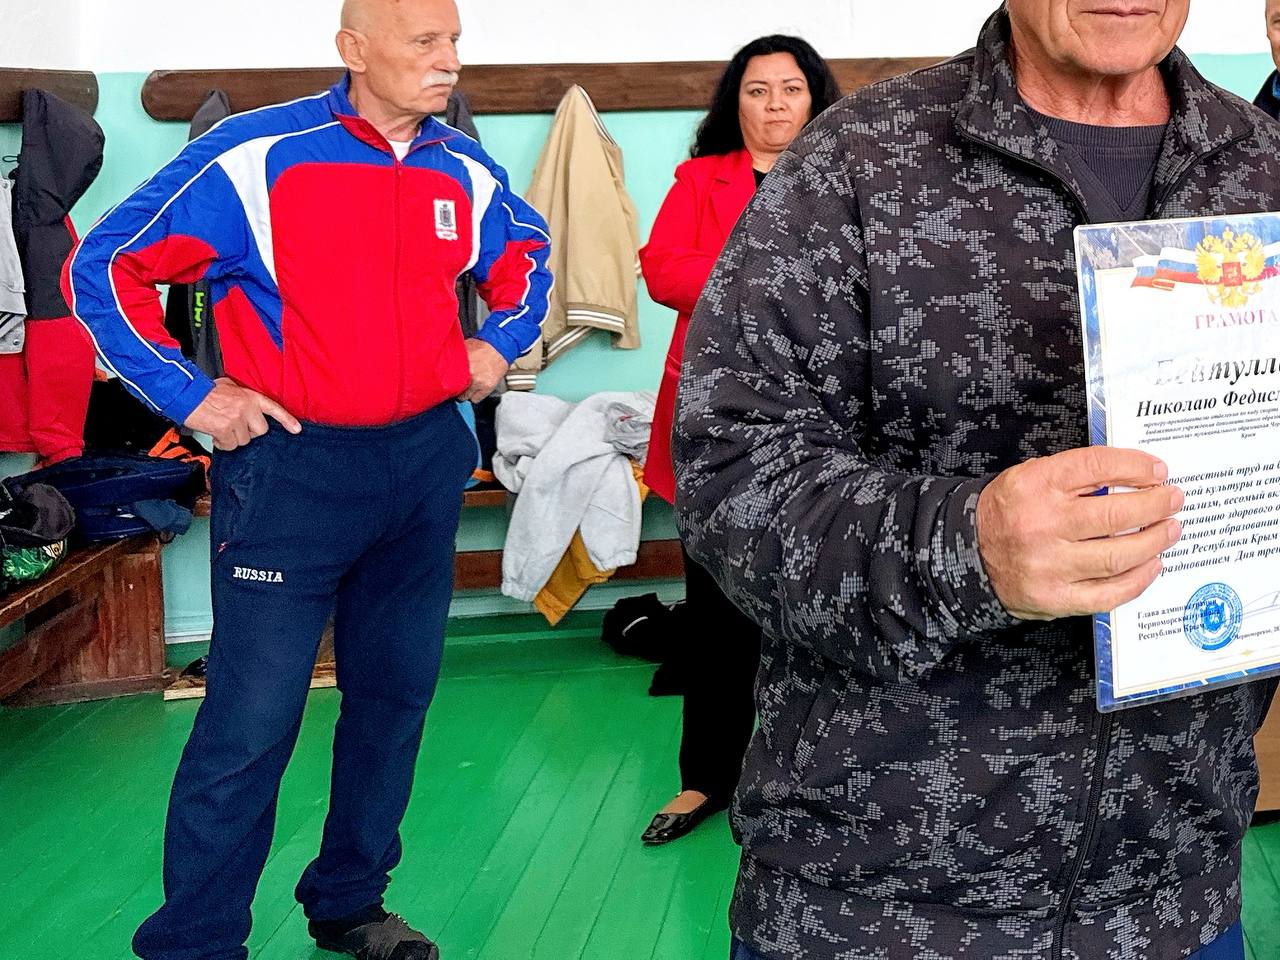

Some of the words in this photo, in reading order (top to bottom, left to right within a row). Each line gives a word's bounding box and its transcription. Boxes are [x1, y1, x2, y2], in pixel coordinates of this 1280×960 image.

[1194, 308, 1278, 329] ГРАМОТА
[1135, 396, 1217, 418] Николаю
[1236, 463, 1260, 477] труд
[1263, 463, 1274, 471] на
[1206, 477, 1253, 498] культуры
[1224, 490, 1265, 506] весомый
[1227, 503, 1273, 520] здорового
[1219, 518, 1279, 536] образовании
[1192, 536, 1248, 555] Республики
[1251, 532, 1278, 545] Крым
[1234, 549, 1255, 562] Дня
[232, 566, 284, 583] RUSSIA
[1137, 609, 1160, 619] Глава
[1138, 626, 1182, 641] Республики
